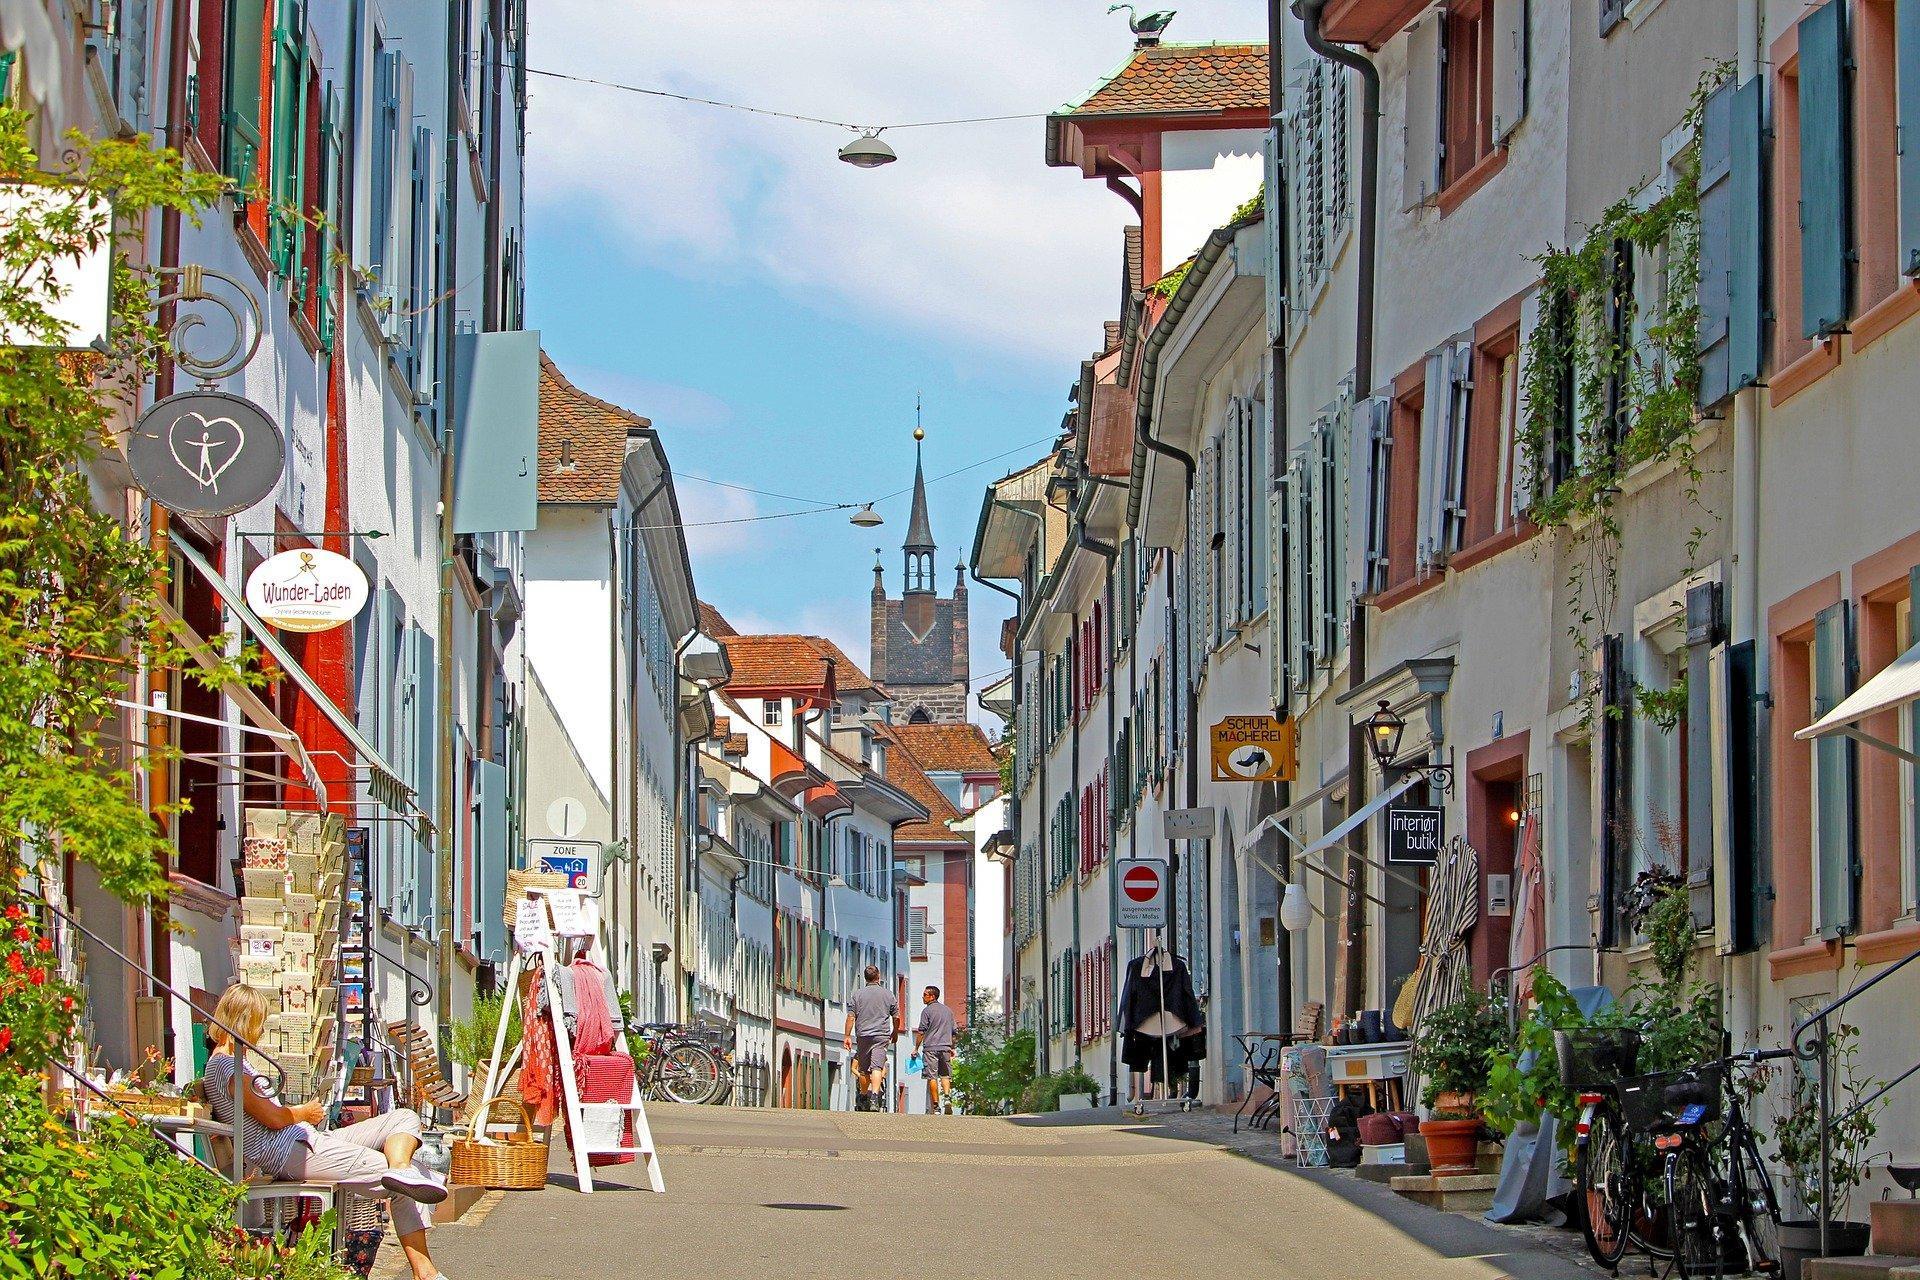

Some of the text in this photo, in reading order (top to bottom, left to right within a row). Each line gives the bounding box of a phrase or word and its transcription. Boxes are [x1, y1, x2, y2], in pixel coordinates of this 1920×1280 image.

[263, 582, 351, 604] Wunder-Laden
[1227, 718, 1269, 730] SCHUH
[1219, 730, 1281, 742] MACHEREI
[1393, 814, 1437, 832] interiør
[1406, 832, 1437, 850] butik
[553, 846, 577, 856] ZONE
[577, 878, 586, 886] 20
